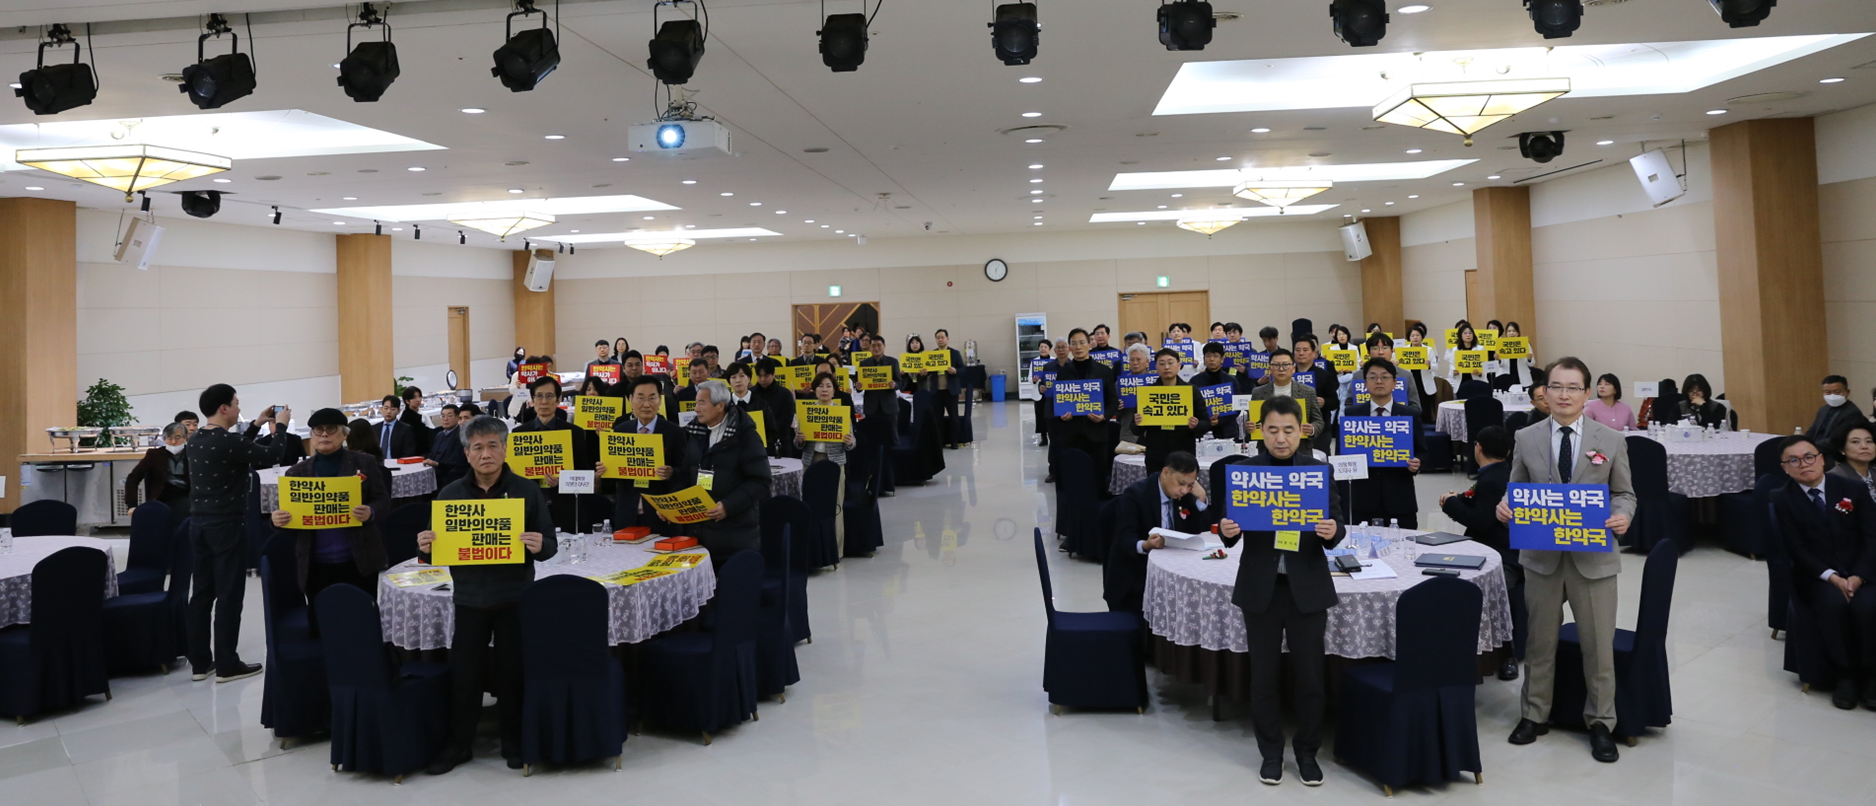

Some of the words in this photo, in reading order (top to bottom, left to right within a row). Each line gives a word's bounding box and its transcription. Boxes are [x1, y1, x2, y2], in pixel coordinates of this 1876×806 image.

[1120, 377, 1144, 386] 약사는
[1297, 374, 1313, 383] 약국
[1056, 383, 1081, 392] 약사는
[1083, 382, 1100, 391] 약국
[1121, 387, 1136, 396] 한약
[1200, 389, 1214, 398] 사는
[1216, 386, 1231, 395] 약국
[582, 398, 602, 406] 한약사
[1056, 393, 1090, 403] 한약사는
[1149, 394, 1180, 404] 국민은
[1206, 397, 1223, 407] 사는
[582, 405, 615, 414] 일반의약품
[807, 407, 829, 415] 한약사
[1076, 403, 1101, 412] 한약국
[1143, 406, 1163, 416] 속고
[1167, 406, 1188, 416] 있다
[807, 416, 843, 424] 일반의약품
[821, 424, 842, 432] 판매는
[1344, 421, 1380, 434] 약사는
[1385, 421, 1409, 434] 약국
[513, 435, 543, 445] 한약사
[608, 435, 635, 446] 한약사
[1344, 434, 1393, 448] 한약사는
[513, 444, 563, 456] 일반의약품
[608, 446, 654, 457] 일반의약품
[1373, 449, 1410, 462] 한약국
[534, 455, 563, 465] 판매는
[627, 457, 655, 467] 판매는
[525, 466, 564, 477] 불법이다
[618, 466, 656, 477] 불법이다
[290, 480, 325, 491] 한약사
[1231, 471, 1283, 489] 약사는
[1289, 472, 1324, 489] 약국
[290, 492, 350, 502] 일반의약품
[1231, 490, 1301, 507] 한약사는
[1513, 488, 1564, 507] 약사는
[1569, 490, 1604, 508] 약국
[314, 503, 350, 515] 판매는
[445, 504, 485, 517] 한약사
[678, 505, 707, 515] 판매는
[302, 514, 351, 526] 불법이다
[1272, 509, 1324, 525] 한약국
[1513, 507, 1583, 526] 한약사는
[445, 517, 511, 533] 일반의약품
[472, 532, 511, 546] 판매는
[1554, 527, 1607, 546] 한약국
[458, 547, 512, 561] 불법이다
